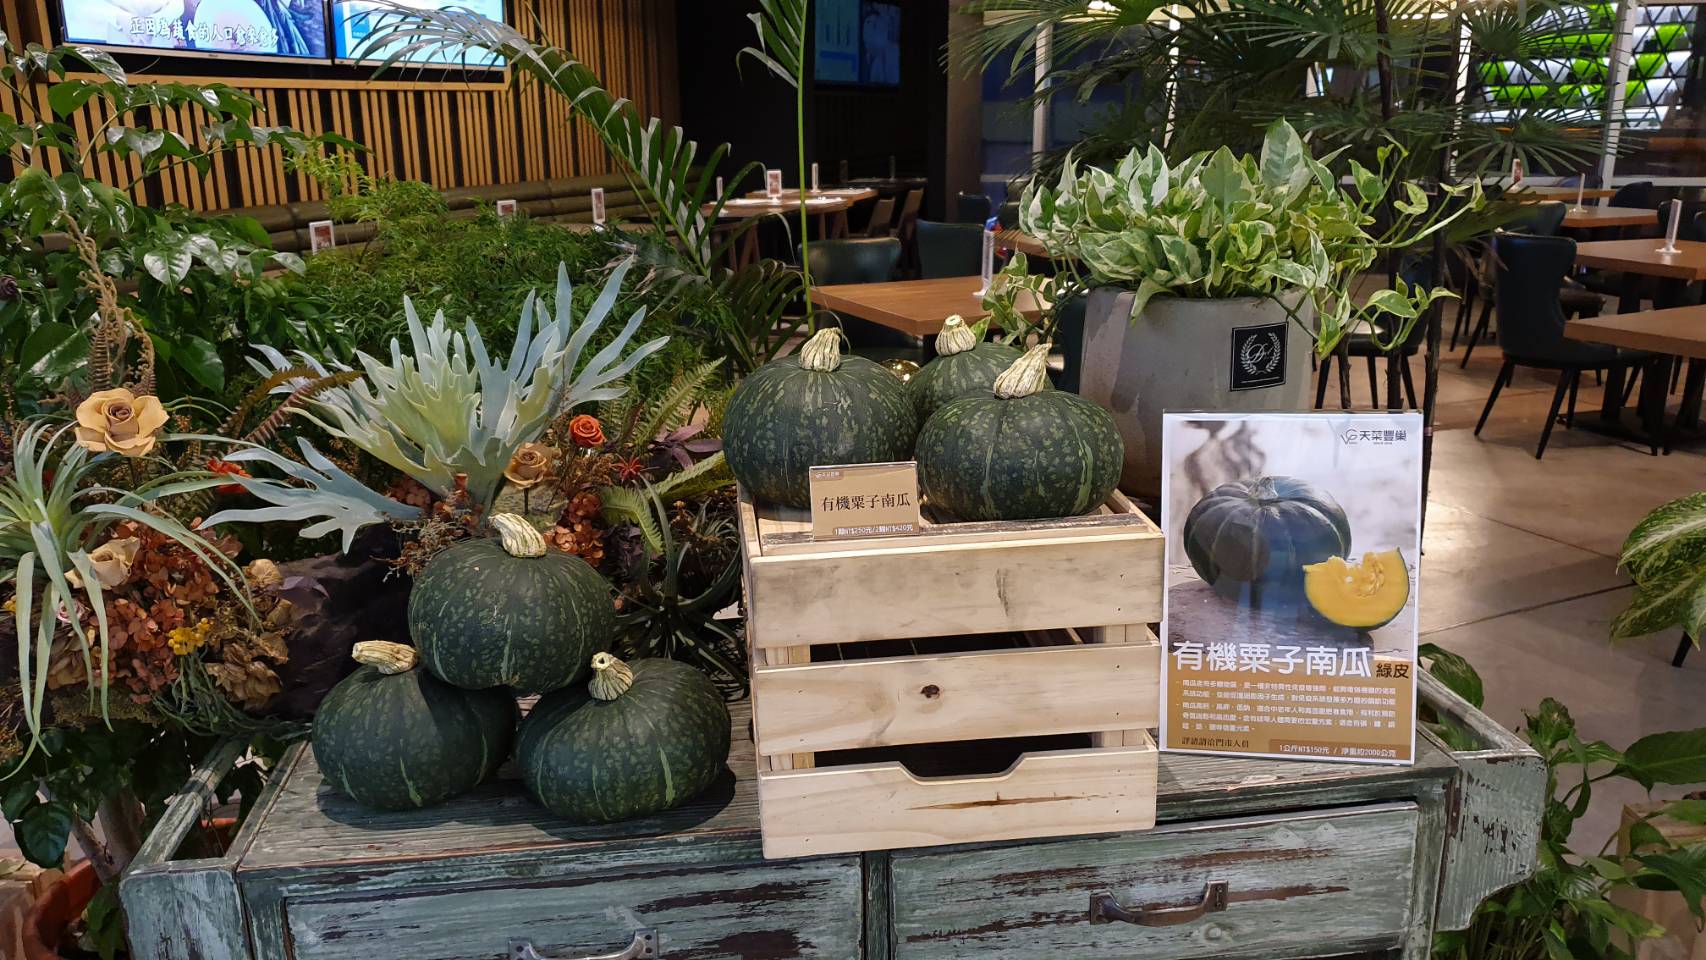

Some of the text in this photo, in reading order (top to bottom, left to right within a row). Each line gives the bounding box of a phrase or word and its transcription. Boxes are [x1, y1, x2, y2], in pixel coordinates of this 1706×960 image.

[1173, 641, 1371, 677] 有機粟子南瓜
[1376, 662, 1409, 679] 綠皮
